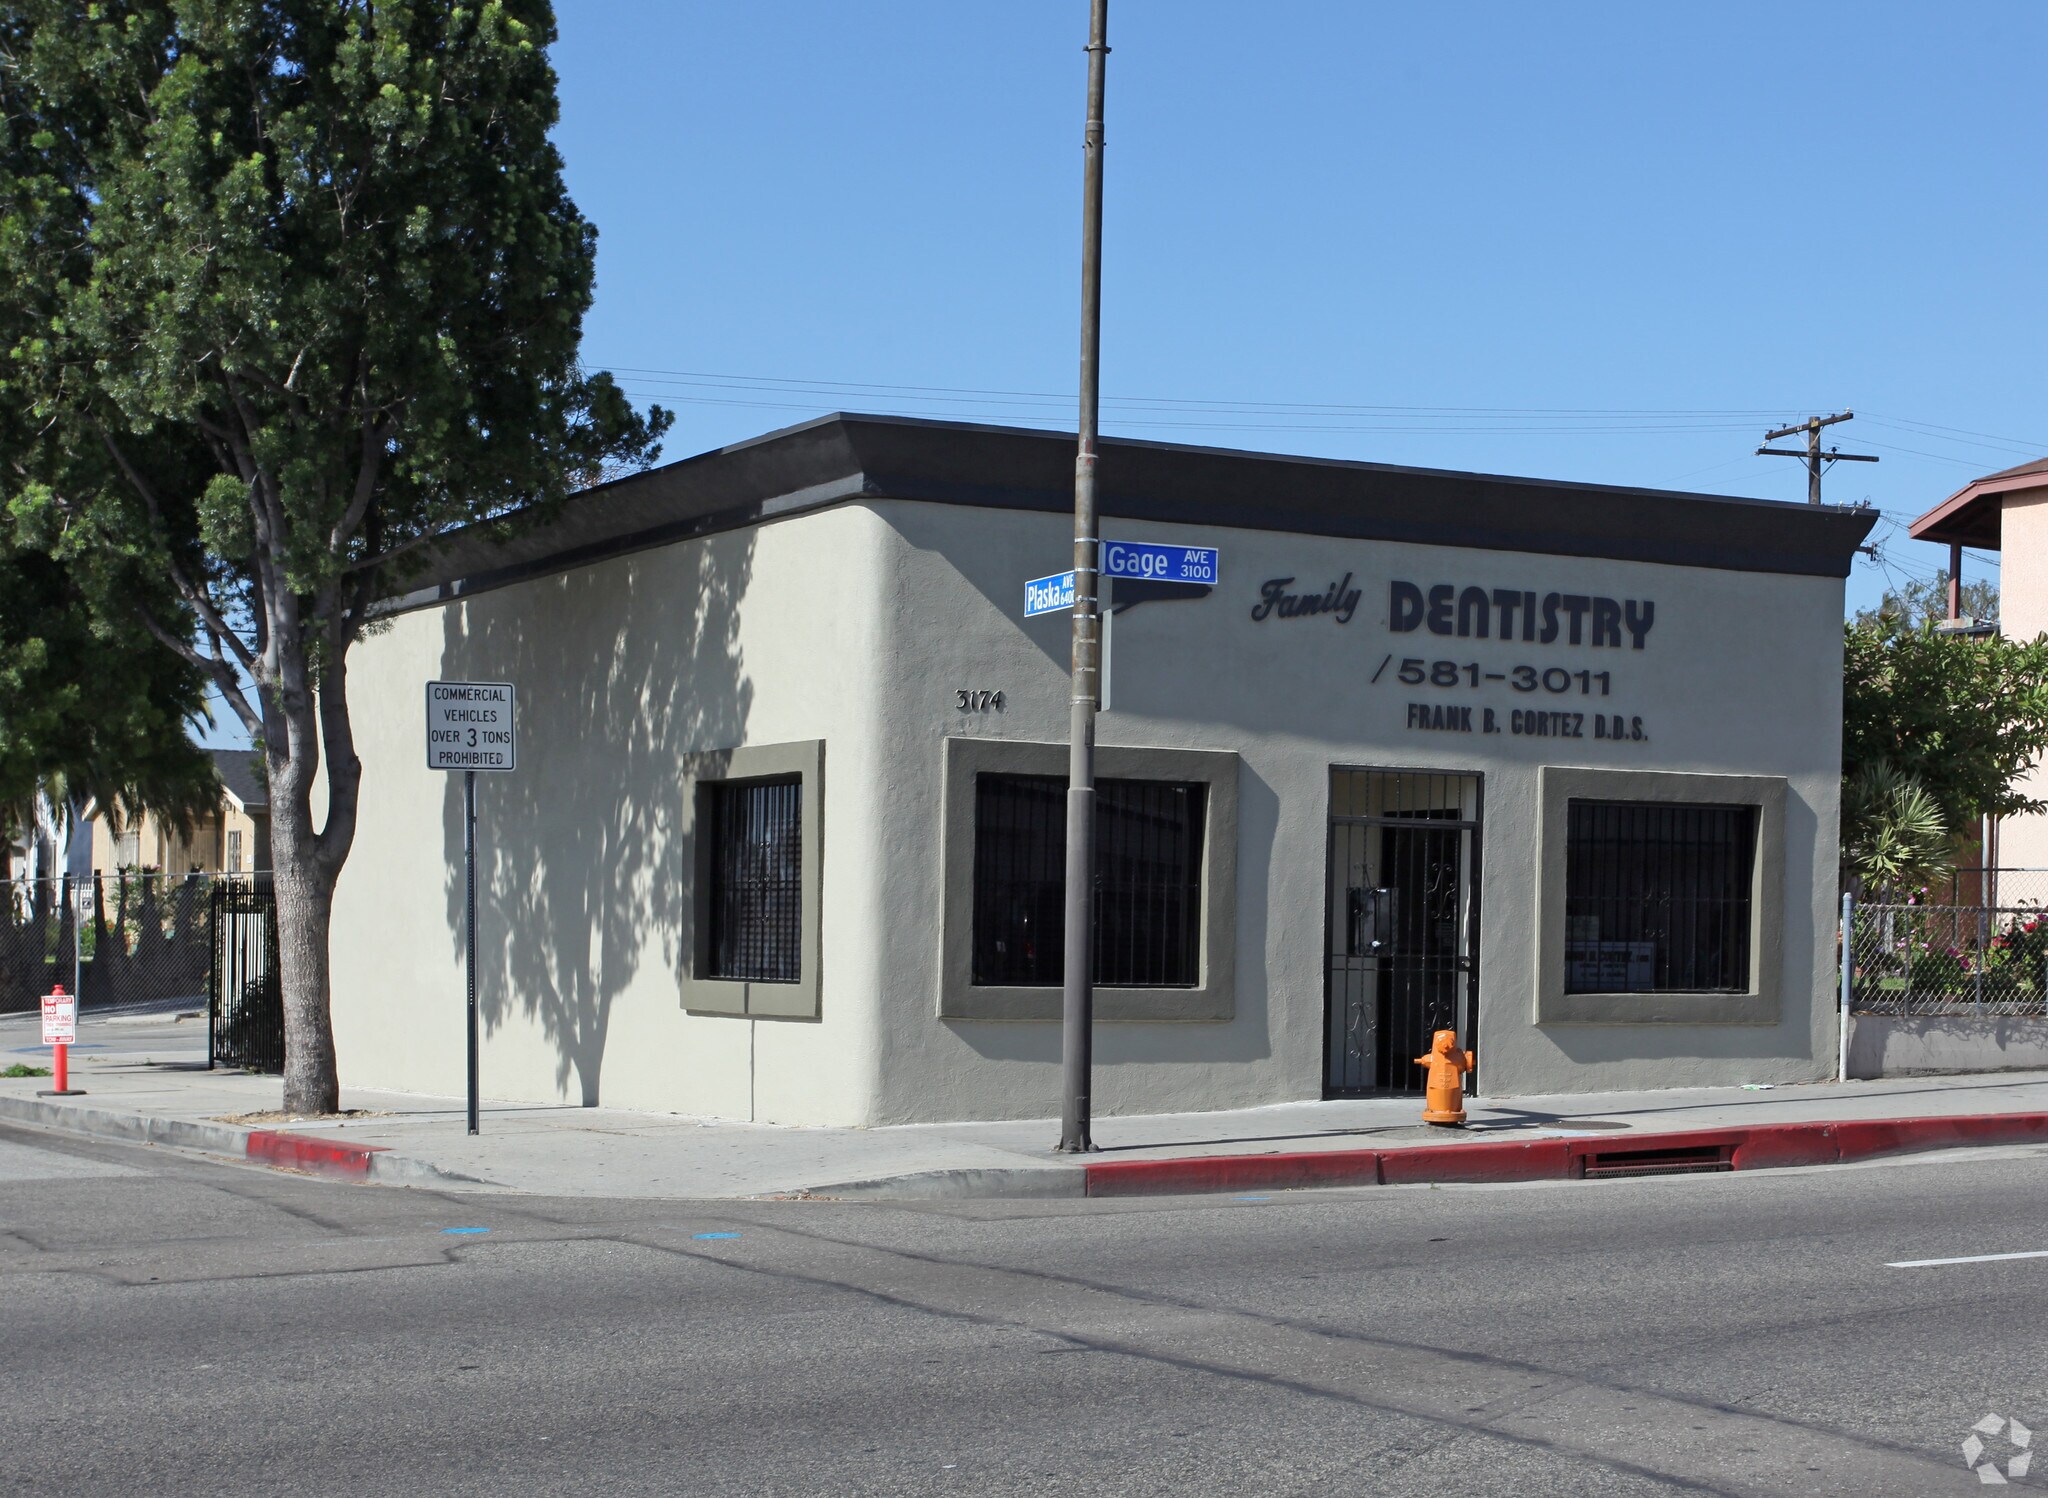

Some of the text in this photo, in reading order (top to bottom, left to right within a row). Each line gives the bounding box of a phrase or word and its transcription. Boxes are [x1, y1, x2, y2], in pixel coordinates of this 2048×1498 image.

[1108, 546, 1168, 577] Gage
[1183, 550, 1209, 564] AVE
[1180, 565, 1211, 579] 3100
[1062, 573, 1074, 590] AVE
[1027, 580, 1060, 612] Plaska
[1251, 571, 1362, 625] Family
[1388, 580, 1655, 650] DENTISTRY
[434, 687, 506, 702] COMMERCIAL
[954, 688, 1002, 710] 3174
[444, 709, 498, 723] VEHICLES
[1406, 703, 1649, 742] FRANK B. CORTEZ D.D.S.
[431, 728, 511, 748] OVER 3 TONS
[439, 751, 504, 765] PROHIBITED
[45, 1006, 55, 1014] NO
[45, 1014, 72, 1022] PARKING
